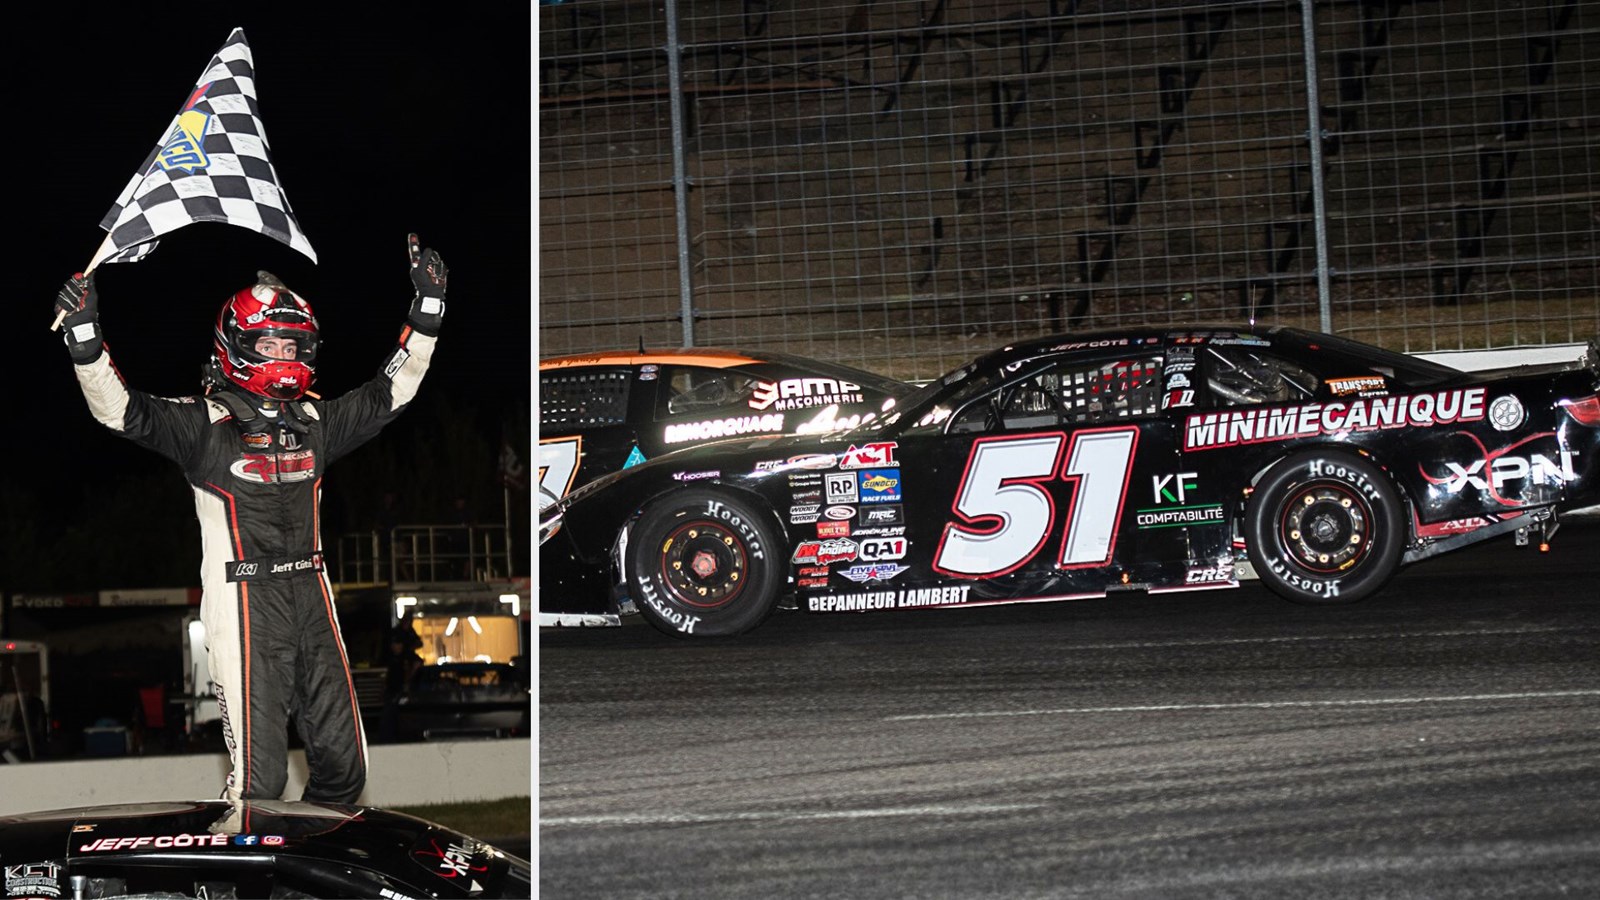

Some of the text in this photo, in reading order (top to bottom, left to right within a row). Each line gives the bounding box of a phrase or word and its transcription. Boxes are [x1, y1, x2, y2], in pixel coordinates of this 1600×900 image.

[1050, 342, 1089, 351] JEFF
[1328, 379, 1385, 394] TRANSPORT
[683, 470, 720, 481] HOOSIER
[1308, 459, 1381, 500] Hoosier
[1445, 451, 1575, 494] XPN
[830, 480, 853, 494] RP
[864, 480, 896, 488] SUNOCO
[1153, 473, 1198, 503] KF
[932, 426, 1140, 579] 51
[1137, 506, 1224, 526] COMPTABILITÉ
[703, 500, 763, 560] Hoosier
[863, 541, 903, 558] QA1
[270, 563, 293, 573] Jeff
[1267, 557, 1341, 598] Hoosier
[638, 576, 701, 634] Hoosier
[808, 586, 971, 611] DEPANNEUR LAMBERT
[80, 833, 228, 852] JEFF CÔTÉ
